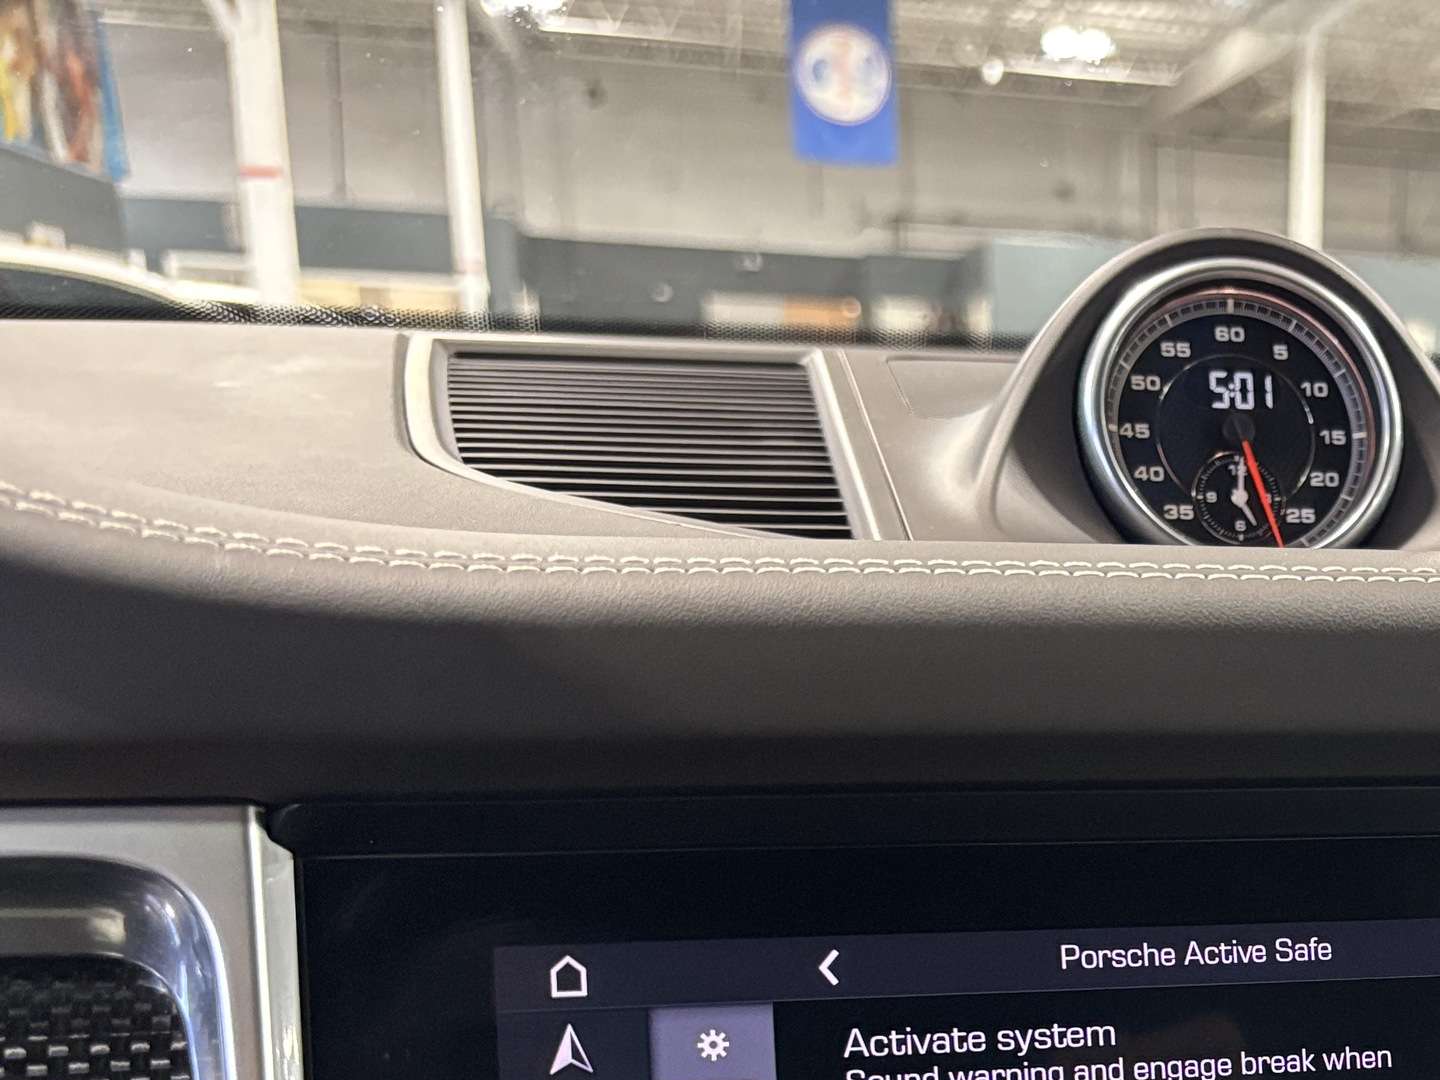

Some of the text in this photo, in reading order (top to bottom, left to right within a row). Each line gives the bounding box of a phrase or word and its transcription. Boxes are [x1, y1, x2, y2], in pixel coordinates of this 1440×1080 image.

[1214, 326, 1246, 343] 60
[1160, 341, 1191, 358] 55
[1272, 344, 1289, 361] 5
[1130, 375, 1161, 391] 50
[1208, 370, 1274, 410] 5:01
[1300, 381, 1329, 398] 10
[1119, 422, 1150, 439] 45
[1319, 429, 1347, 446] 15
[1133, 465, 1165, 482] 40
[1309, 471, 1340, 488] 20
[1205, 491, 1218, 503] 9
[1163, 504, 1195, 520] 35
[1285, 508, 1316, 524] 25
[1234, 520, 1247, 532] 6
[1060, 936, 1333, 970] Porsche Active Safe
[843, 1023, 1116, 1058] Activate system
[1240, 1048, 1316, 1076] break
[1321, 1045, 1393, 1071] when
